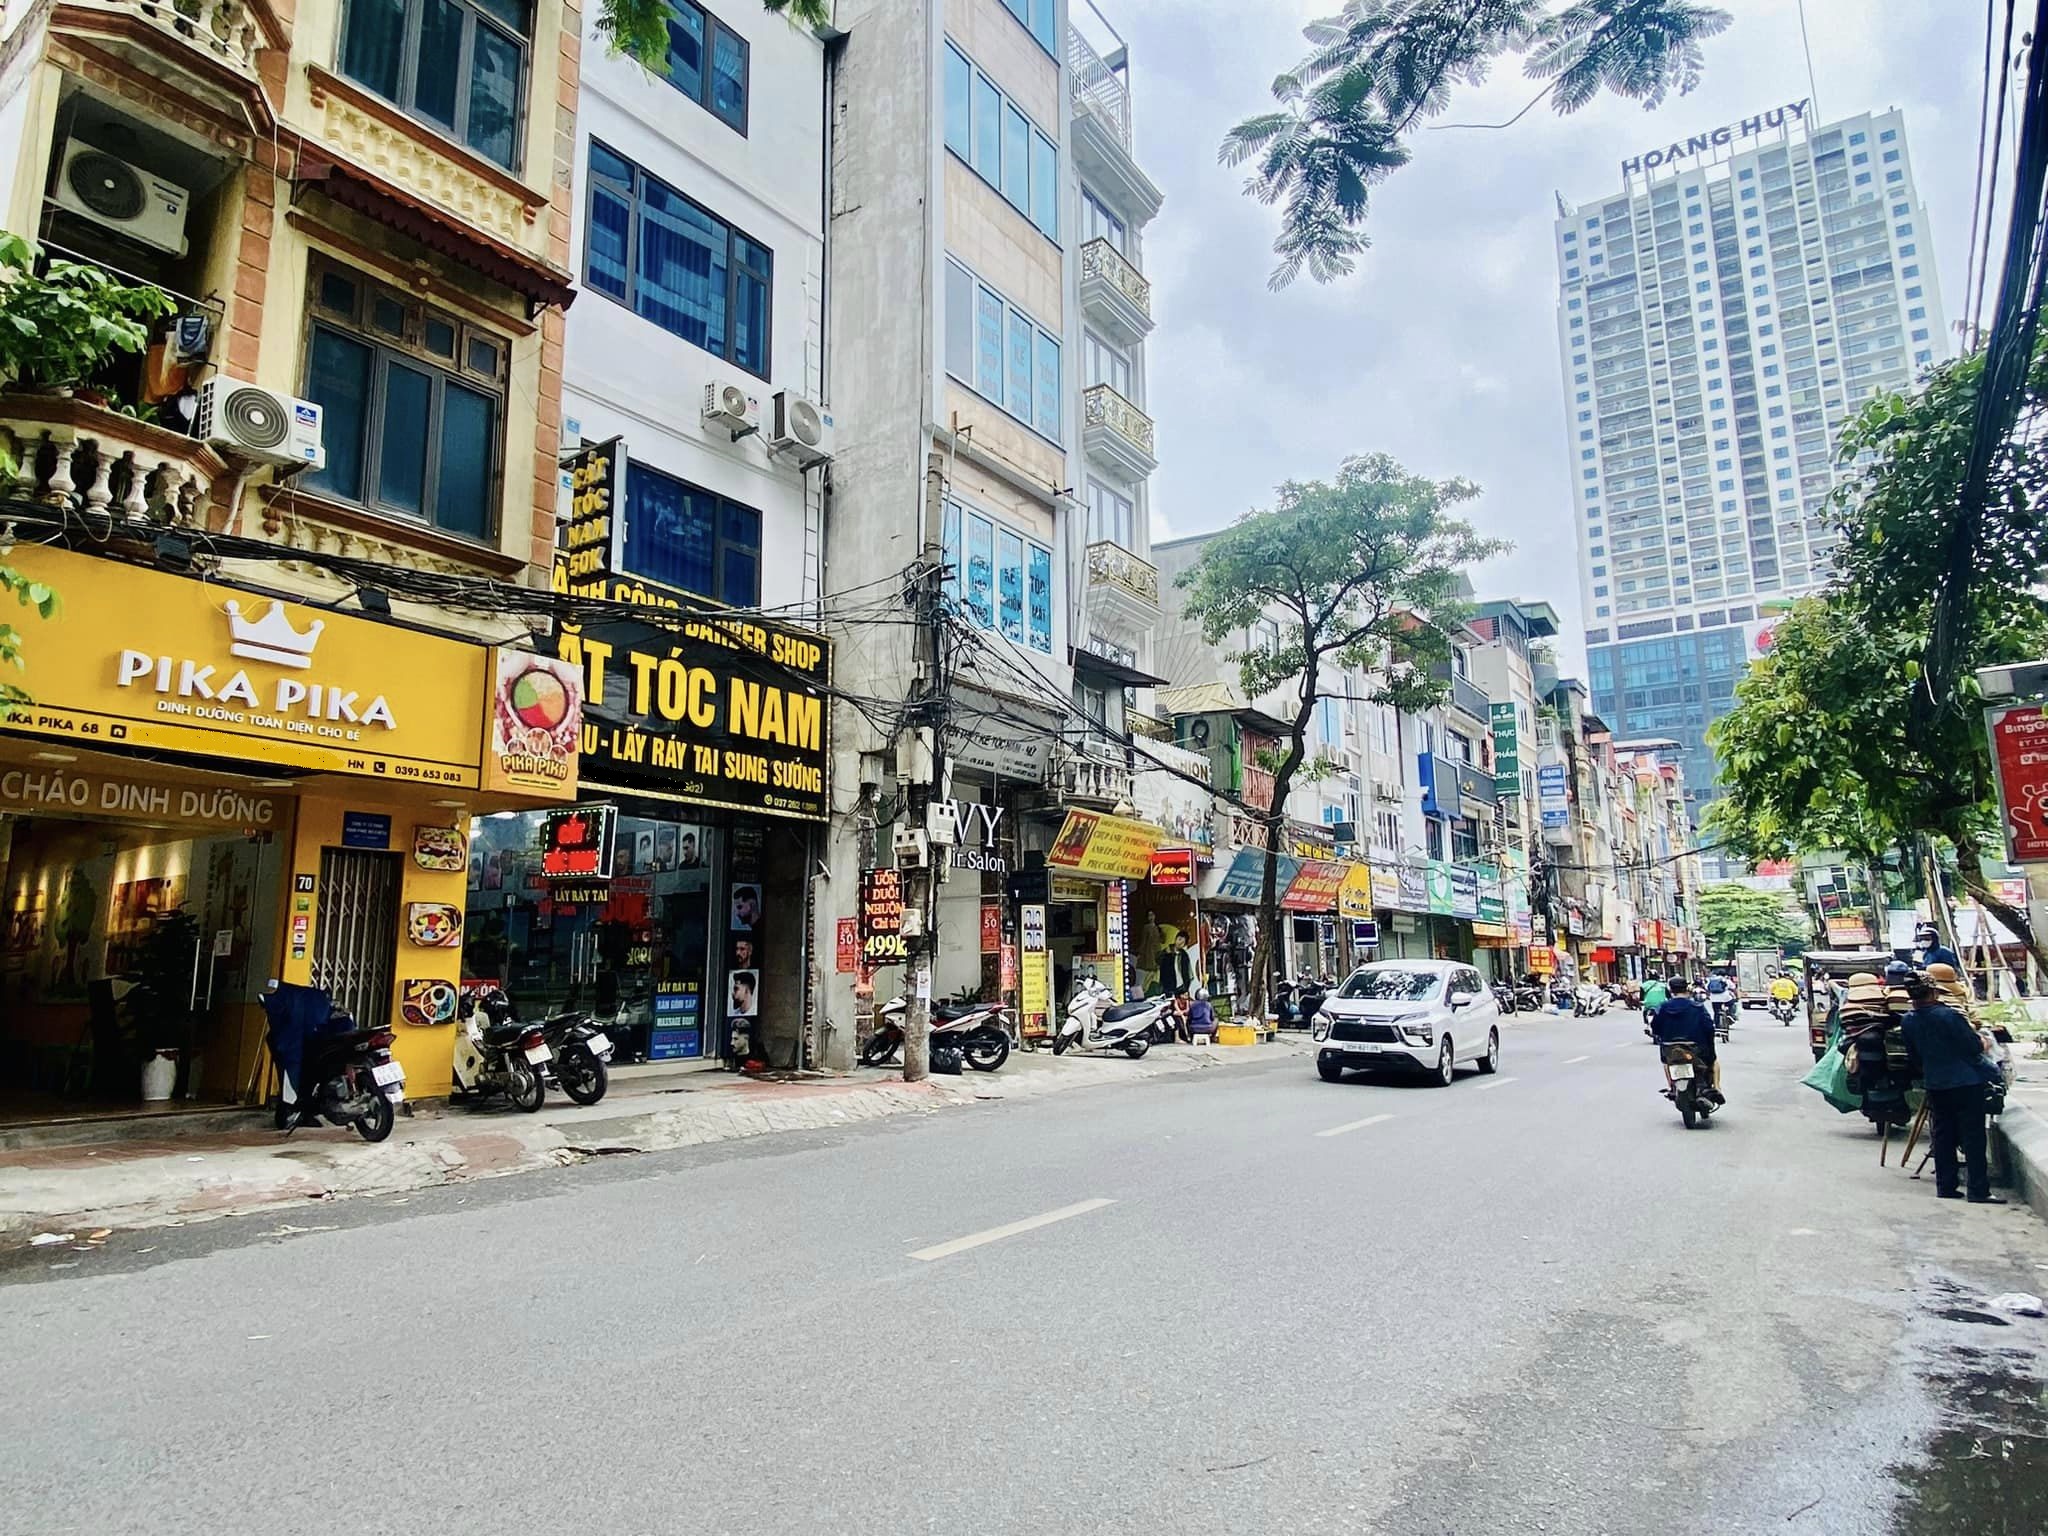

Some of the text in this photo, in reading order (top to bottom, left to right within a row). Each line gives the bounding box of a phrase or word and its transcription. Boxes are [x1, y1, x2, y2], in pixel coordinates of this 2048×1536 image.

[1621, 97, 1811, 177] HOANG HUY
[573, 487, 610, 519] TÓC
[568, 516, 610, 548] NAM
[569, 546, 606, 577] 50K
[771, 632, 821, 671] SHOP
[117, 649, 397, 730] PIKA PIKA
[557, 613, 821, 751] ẮT TÓC NAM
[157, 700, 192, 715] DINH
[195, 705, 245, 723] DƯỠNG
[249, 713, 283, 729] TOÀN
[317, 725, 342, 739] CHO
[346, 728, 361, 741] BÉ
[2005, 720, 2048, 733] BingG
[7, 712, 461, 783] IKA PIKA 68 HN 0393 653 083
[612, 724, 647, 763] LẤY
[652, 734, 688, 770] RÁY
[693, 745, 719, 776] TAI
[724, 751, 768, 784] SUNG
[772, 757, 822, 793] SƯỚNG
[501, 754, 568, 780] PIKA PIKA
[1, 769, 274, 824] CHÁO DINH DƯỠNG
[967, 850, 1006, 873] Salon
[298, 876, 312, 890] 70
[592, 889, 608, 902] TAI
[840, 933, 854, 945] 50
[984, 919, 997, 929] 50
[864, 934, 908, 957] 499k
